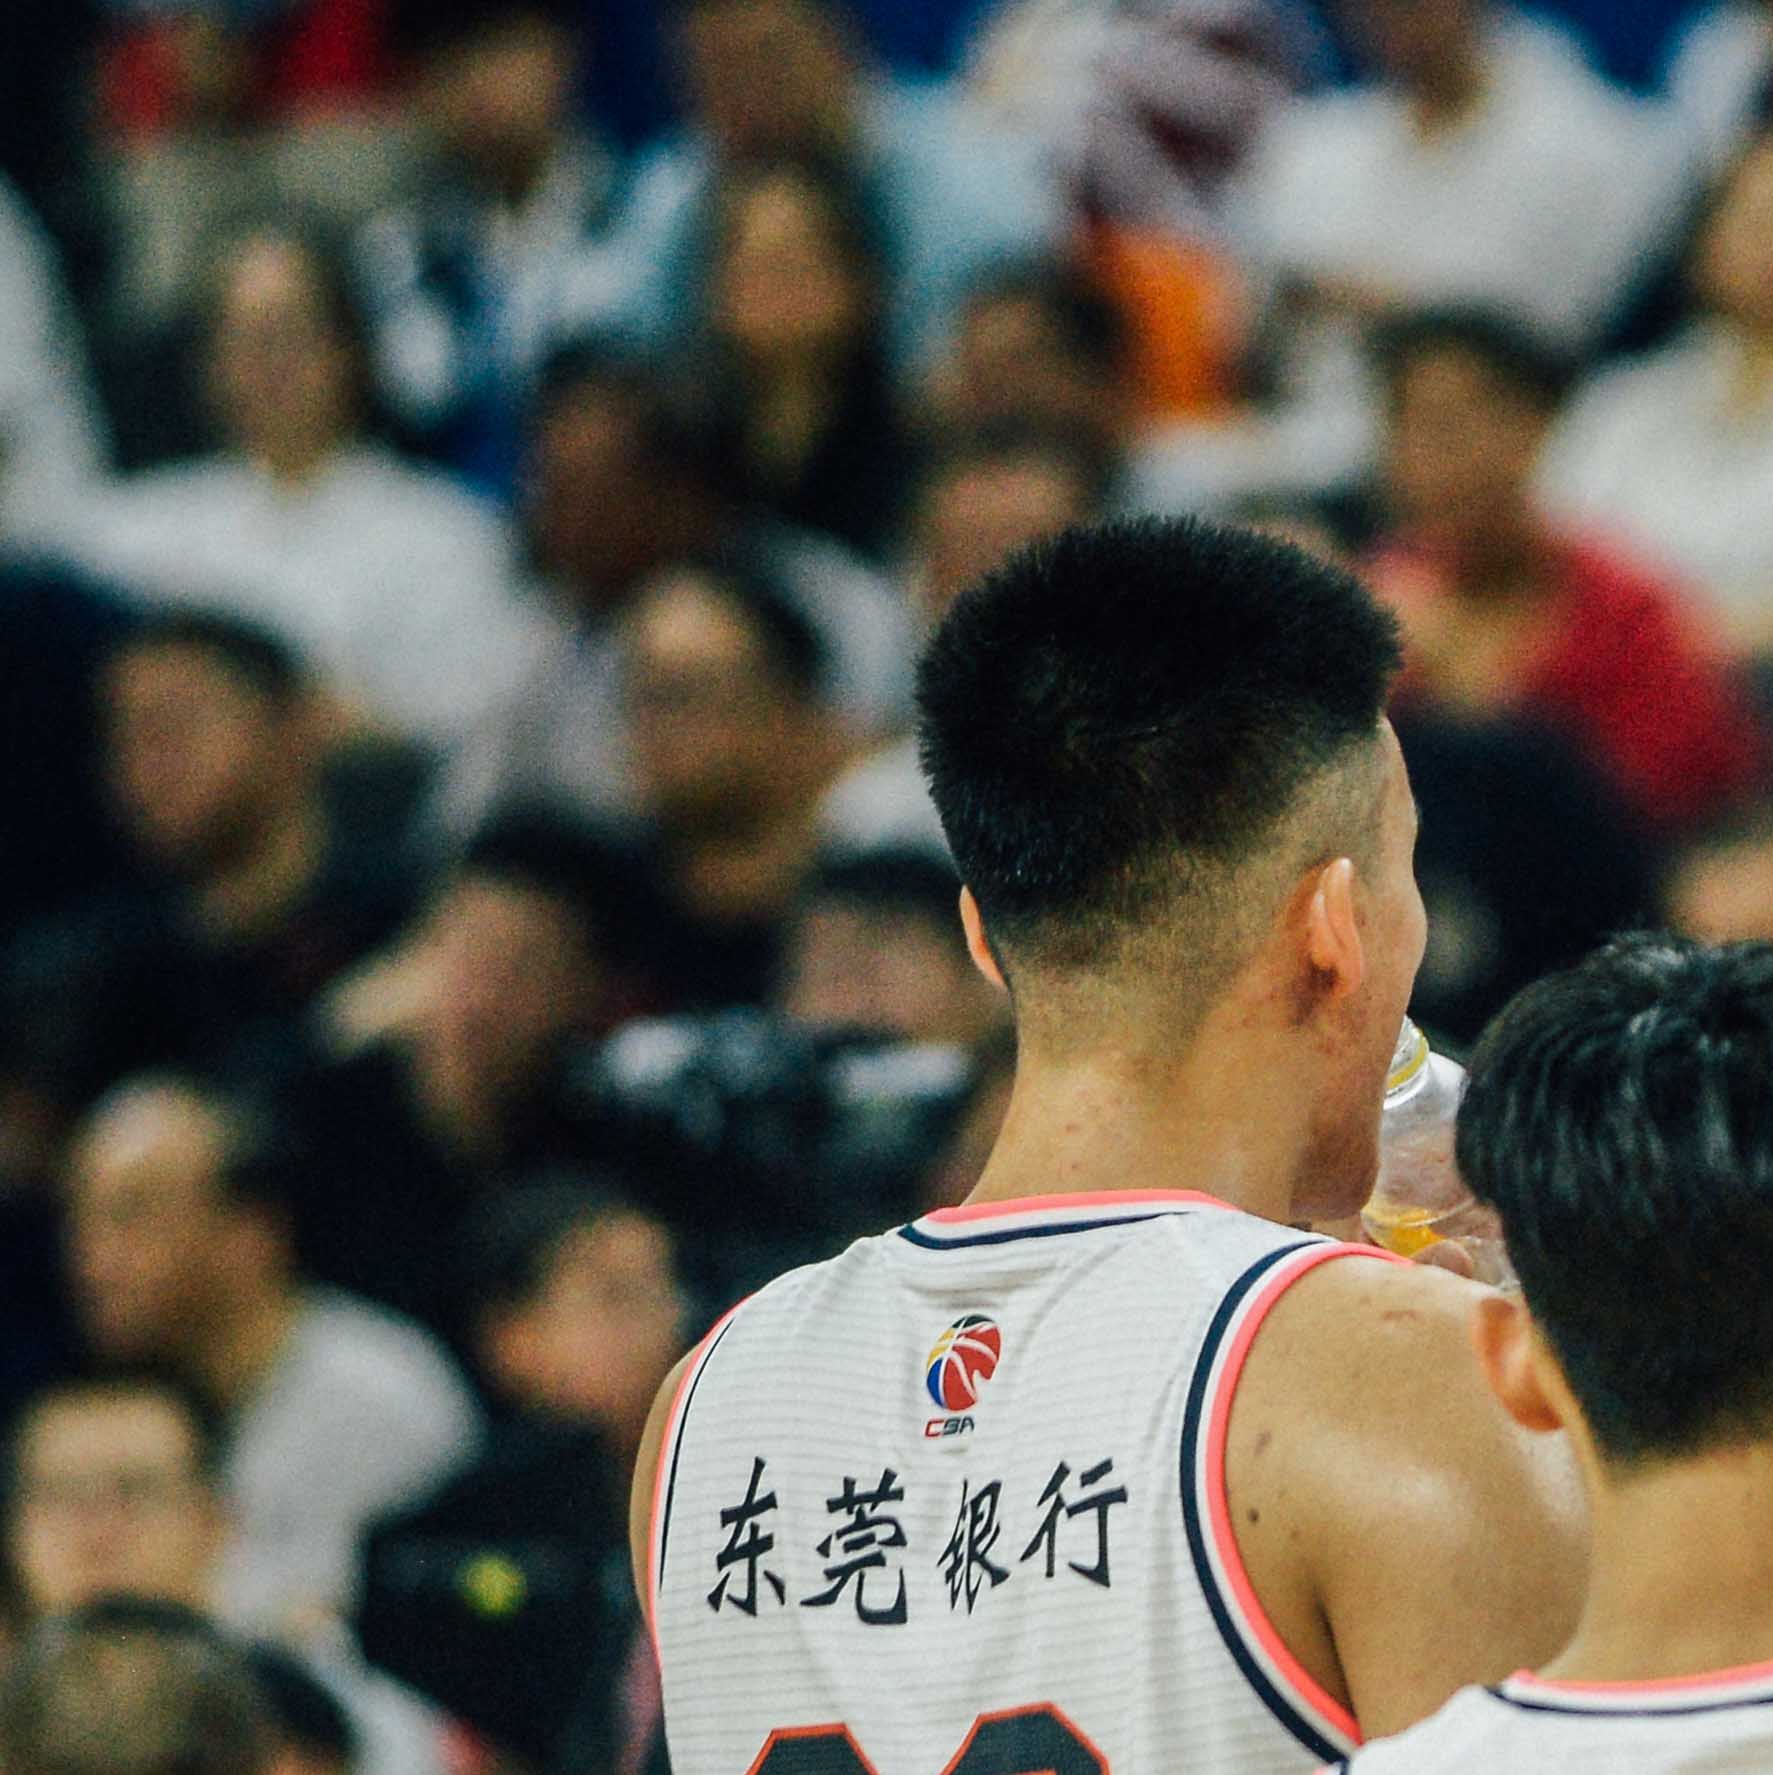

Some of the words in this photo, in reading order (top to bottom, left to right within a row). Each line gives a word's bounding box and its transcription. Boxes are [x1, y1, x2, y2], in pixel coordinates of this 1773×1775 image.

[925, 1416, 974, 1437] CBA
[707, 1456, 1128, 1626] 东莞银行
